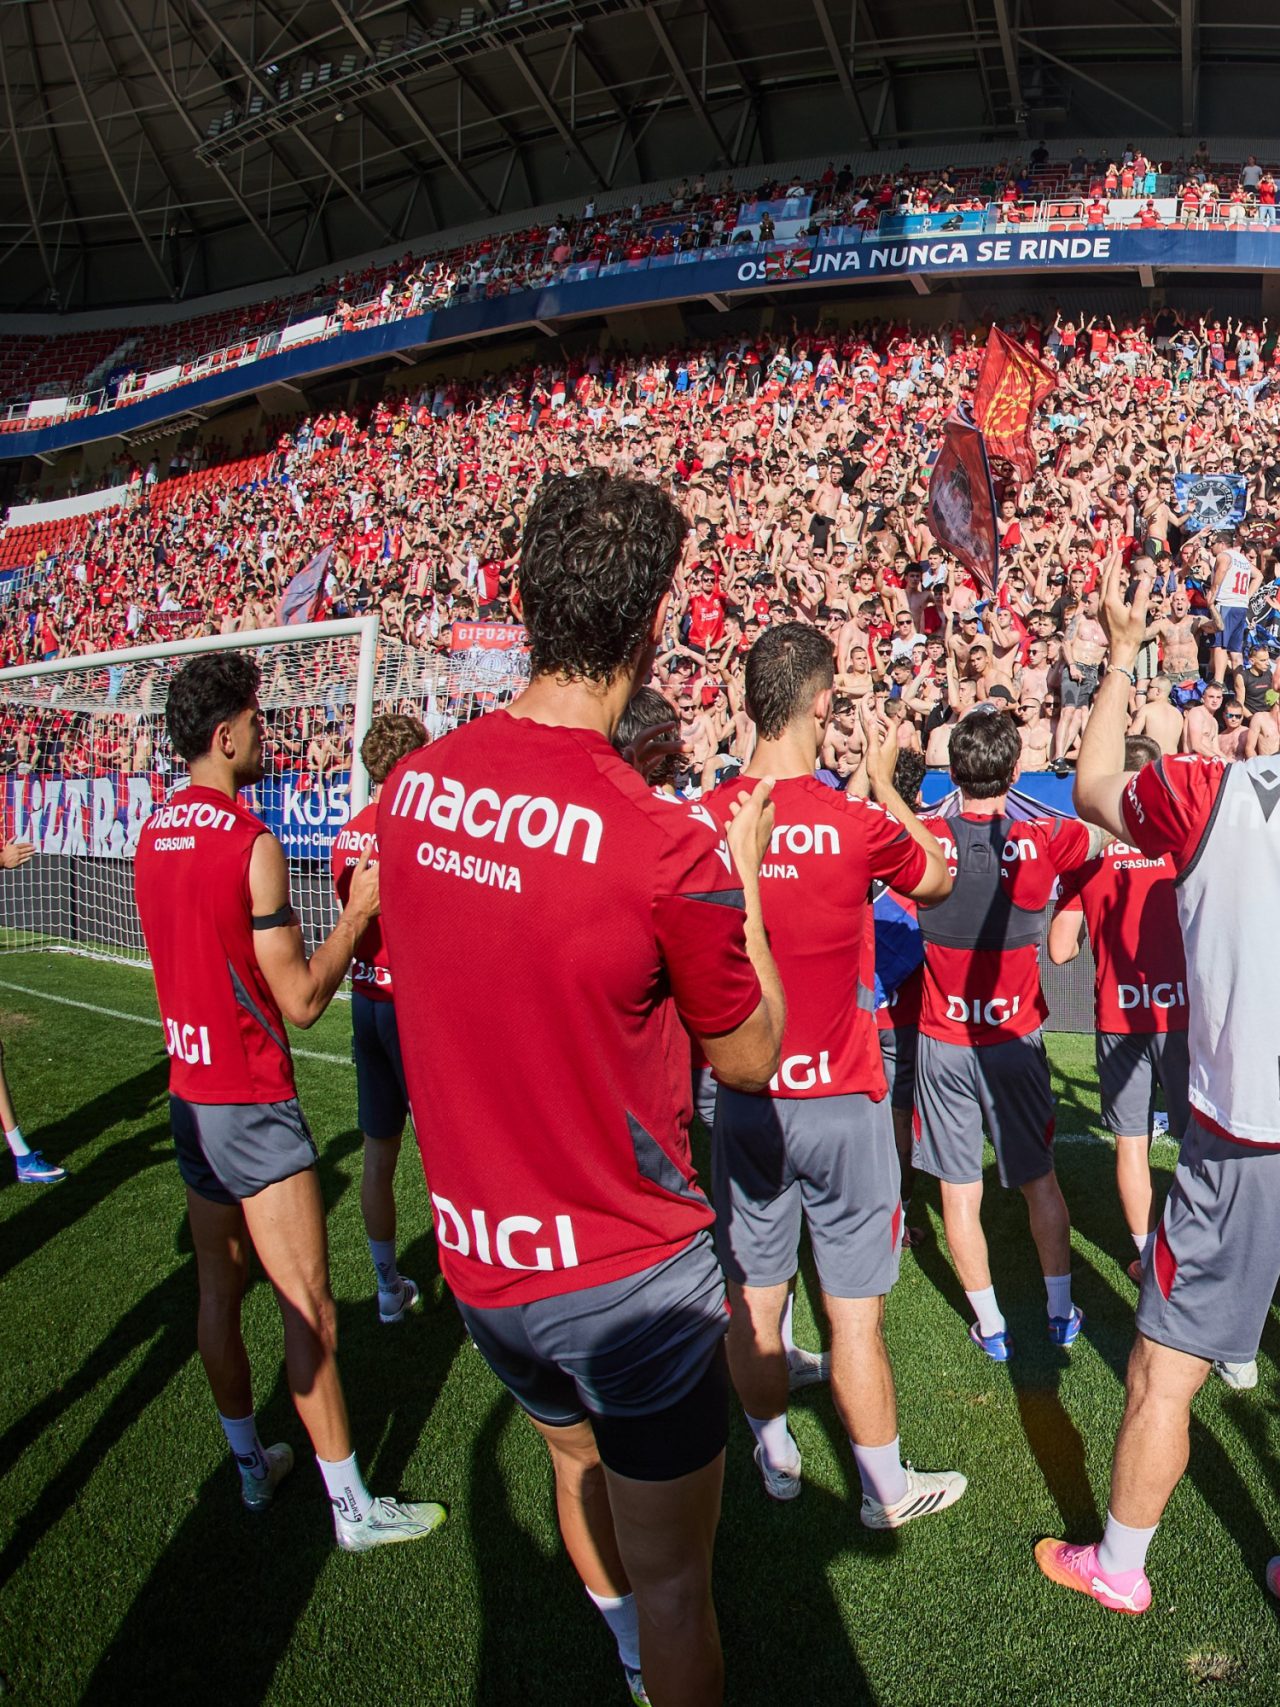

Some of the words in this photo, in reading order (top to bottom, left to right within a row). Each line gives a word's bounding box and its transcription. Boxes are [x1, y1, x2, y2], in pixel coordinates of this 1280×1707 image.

[738, 251, 860, 282] OSUNA
[869, 243, 967, 269] NUNCA
[977, 240, 1011, 261] SE
[1019, 237, 1111, 260] RINDE
[1232, 571, 1249, 595] 10
[390, 770, 604, 864] macron
[154, 836, 196, 851] OSASUNA
[416, 842, 522, 893] OSASUNA
[1113, 857, 1166, 870] OSASUNA
[945, 995, 1020, 1026] DIGI
[1117, 982, 1185, 1009] DIGI
[432, 1191, 579, 1271] DIGI
